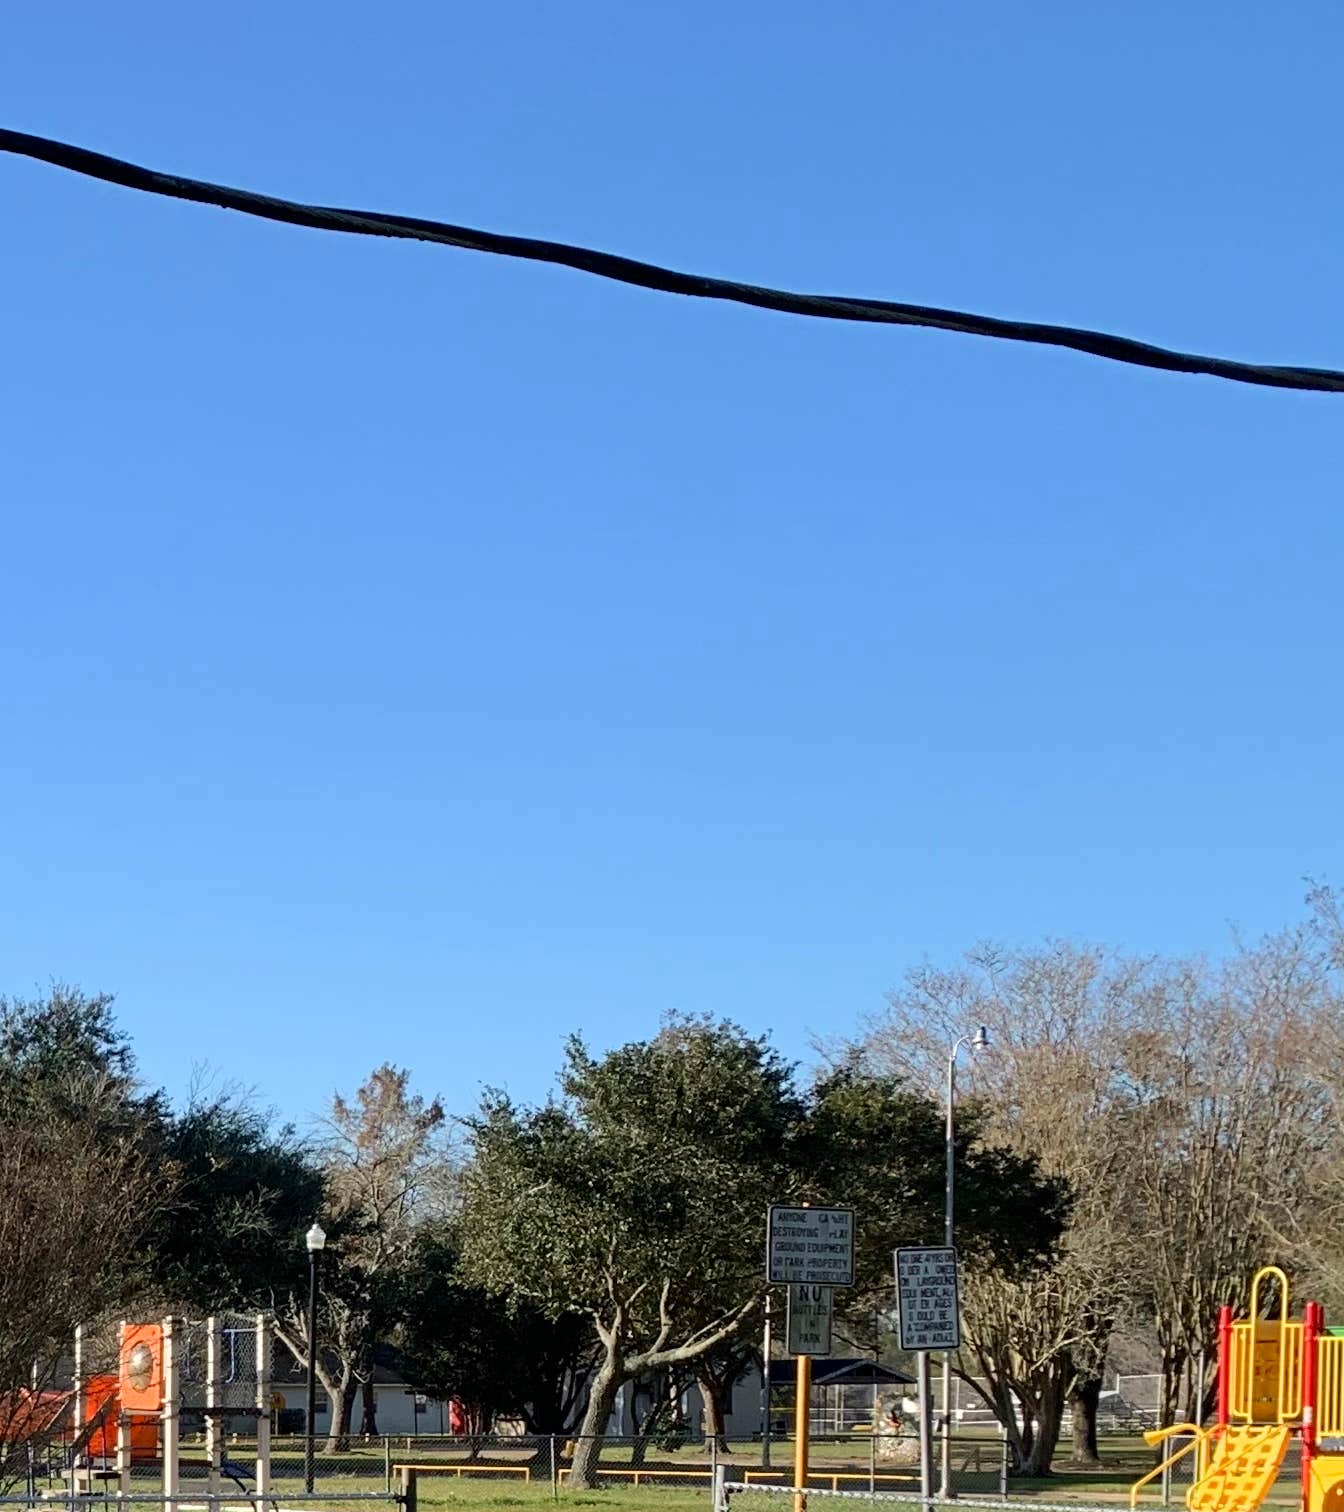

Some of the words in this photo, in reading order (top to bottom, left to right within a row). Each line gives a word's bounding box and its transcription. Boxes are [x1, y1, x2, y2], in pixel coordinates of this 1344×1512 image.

[818, 1213, 848, 1224] CAGHT
[900, 1264, 921, 1276] ODER
[914, 1275, 955, 1287] LAYGROUND
[799, 1285, 822, 1302] NO
[908, 1298, 930, 1310] OTER
[908, 1310, 935, 1322] SOULD
